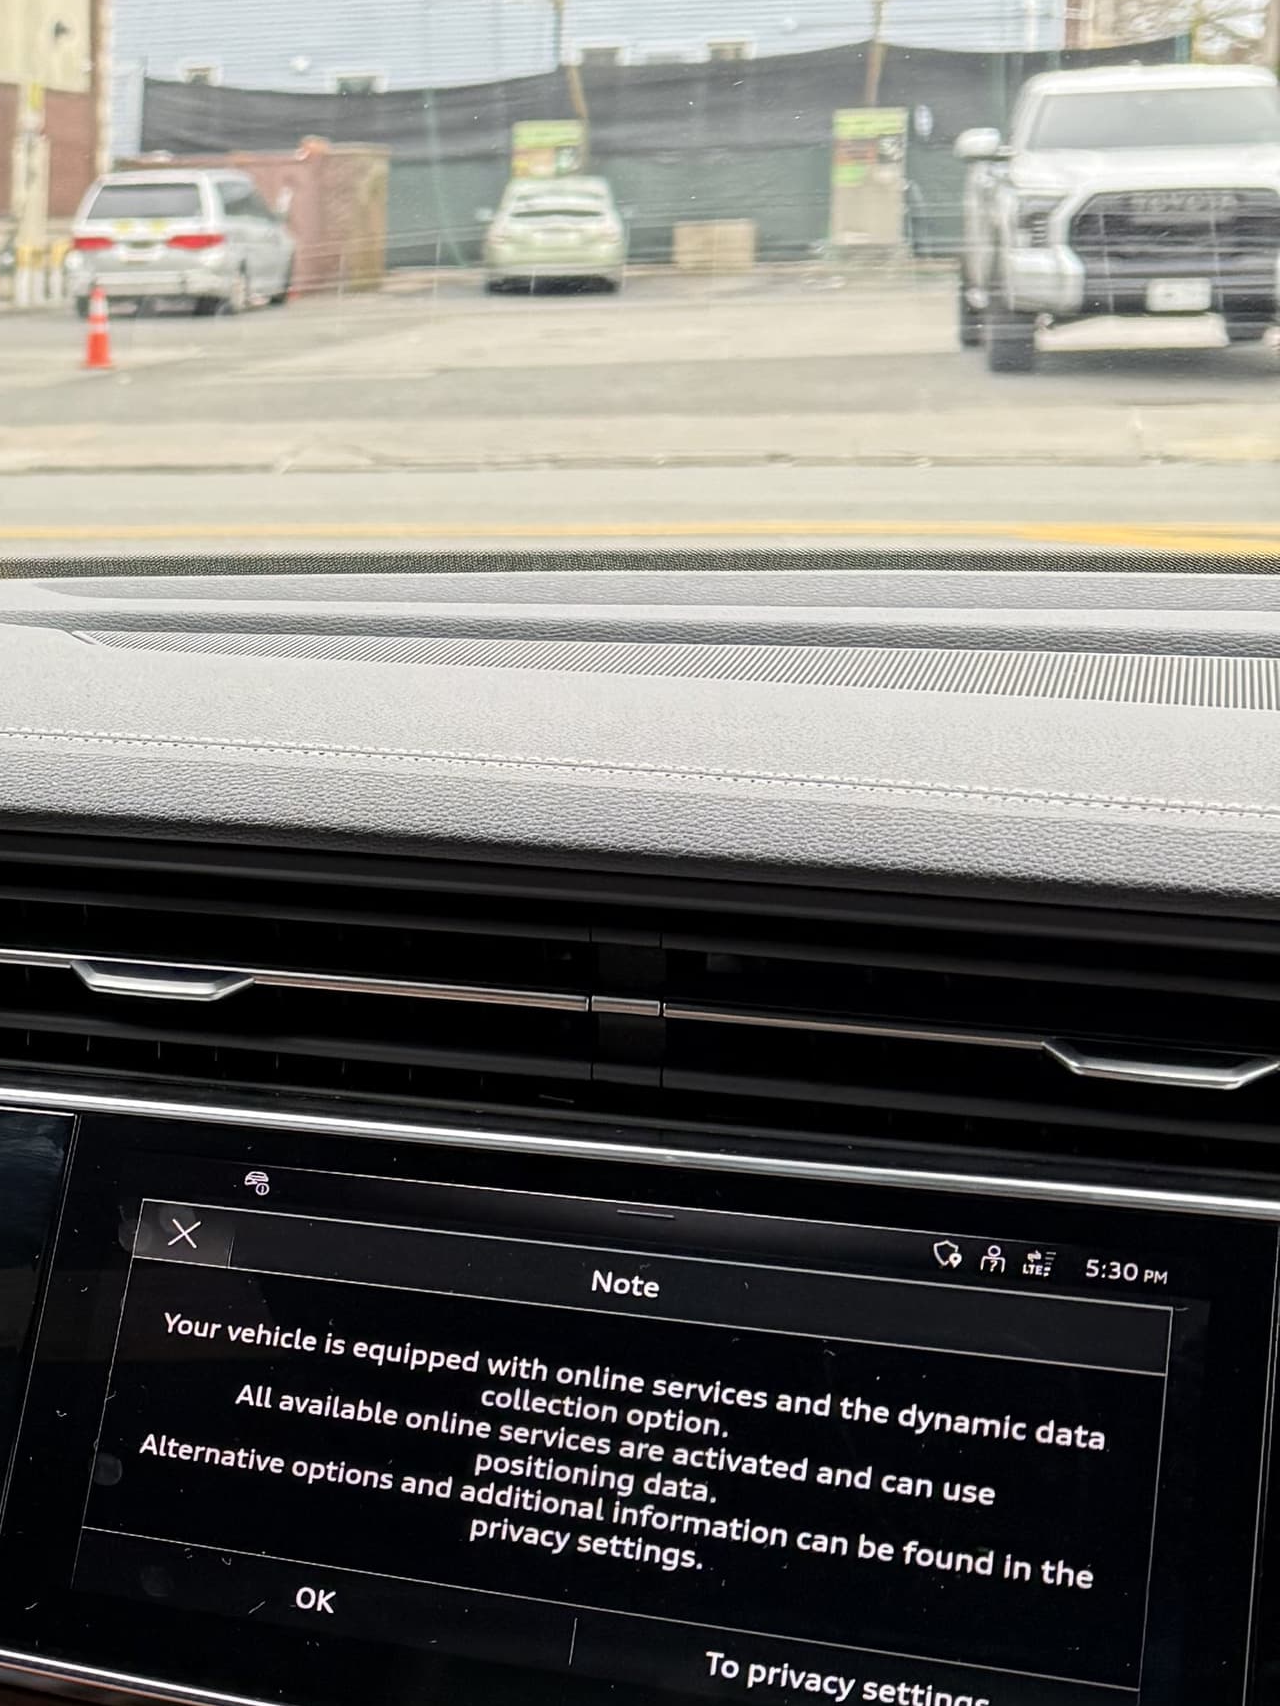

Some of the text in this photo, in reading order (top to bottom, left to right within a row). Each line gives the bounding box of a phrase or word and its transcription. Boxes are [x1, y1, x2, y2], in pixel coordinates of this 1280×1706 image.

[591, 1269, 660, 1298] Note
[1023, 1259, 1168, 1284] LTE 5:30 PM
[164, 1312, 1105, 1451] Your vehicle is equipped with online services and the dynamic data
[481, 1387, 729, 1438] collection option.
[235, 1384, 996, 1506] All available online services are activated and can use
[474, 1453, 717, 1504] positioning data.
[139, 1433, 1094, 1590] Alternative options and additional information can be found in the
[469, 1518, 703, 1571] privacy settings.
[296, 1587, 336, 1613] OK
[706, 1652, 739, 1678] To
[747, 1659, 855, 1702] privacy
